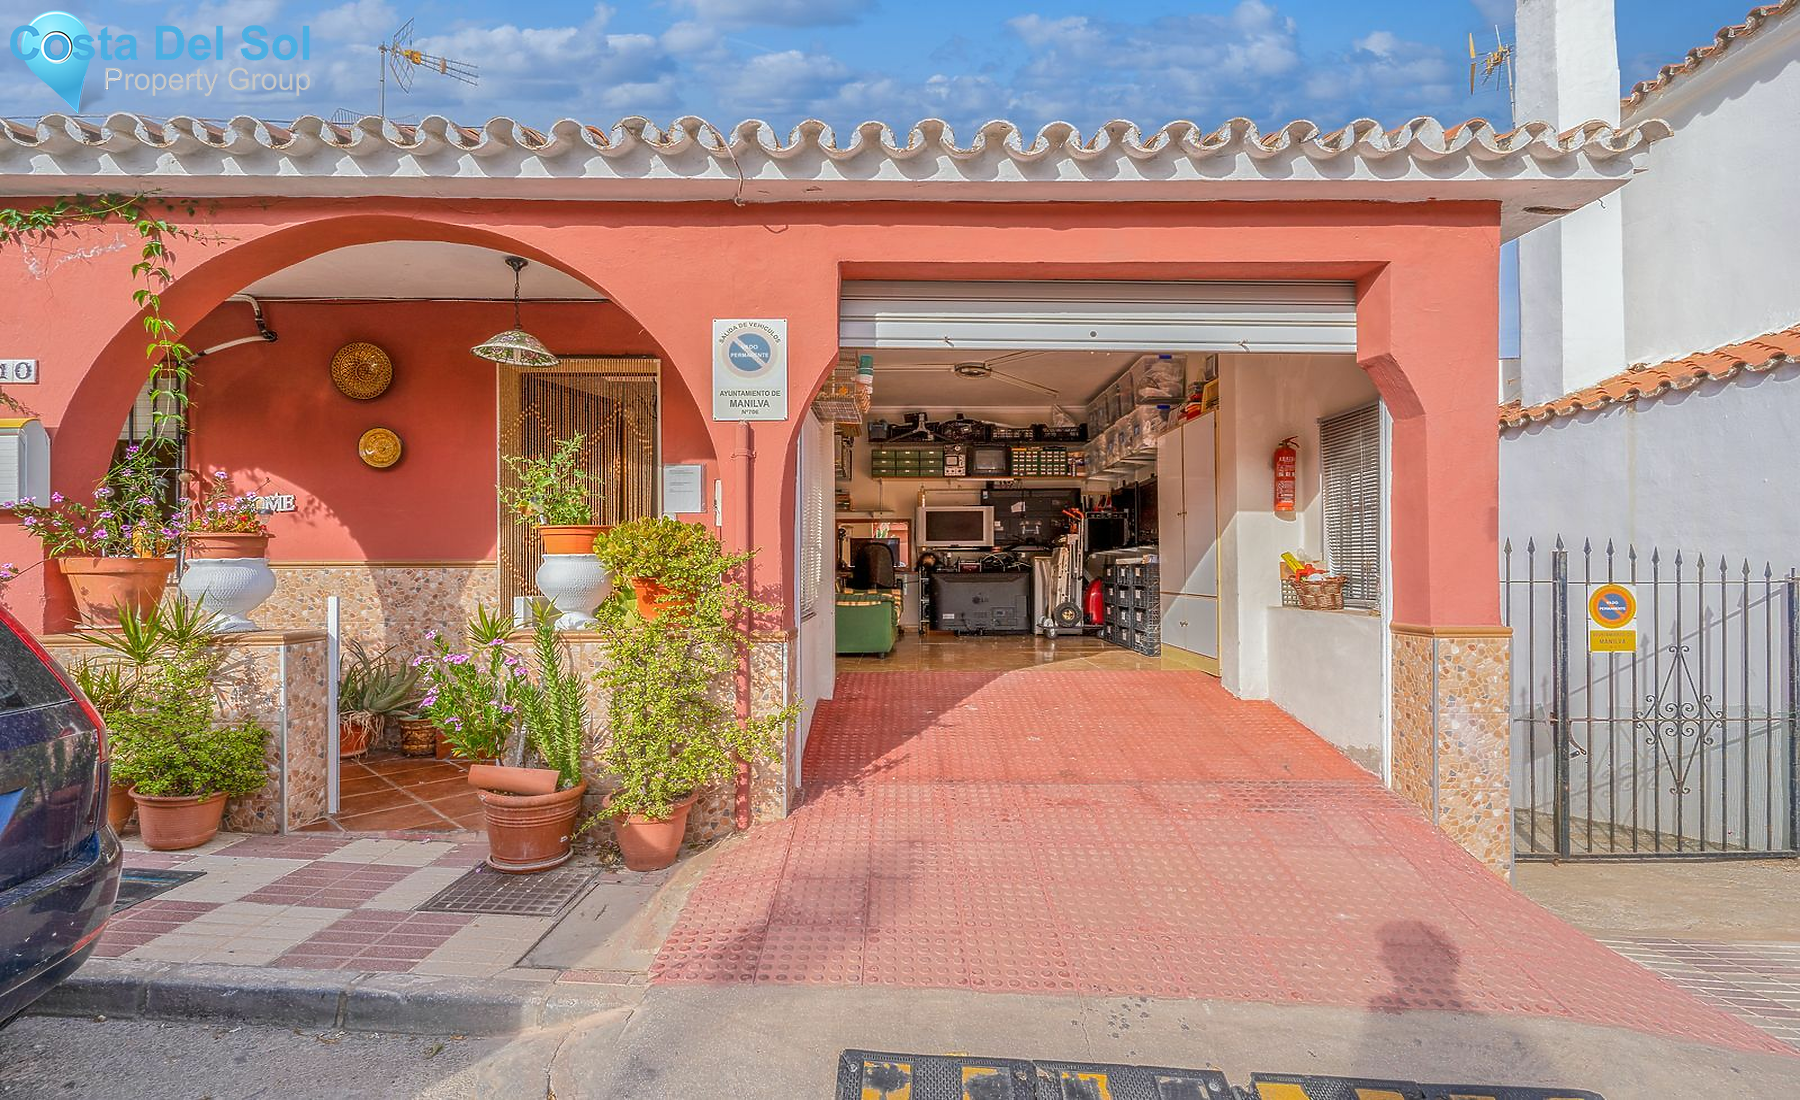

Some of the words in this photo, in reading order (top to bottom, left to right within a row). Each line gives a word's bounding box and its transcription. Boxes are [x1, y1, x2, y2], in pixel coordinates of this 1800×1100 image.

[719, 326, 738, 344] SALIDA
[729, 399, 770, 408] MANILVA
[252, 494, 297, 511] OME
